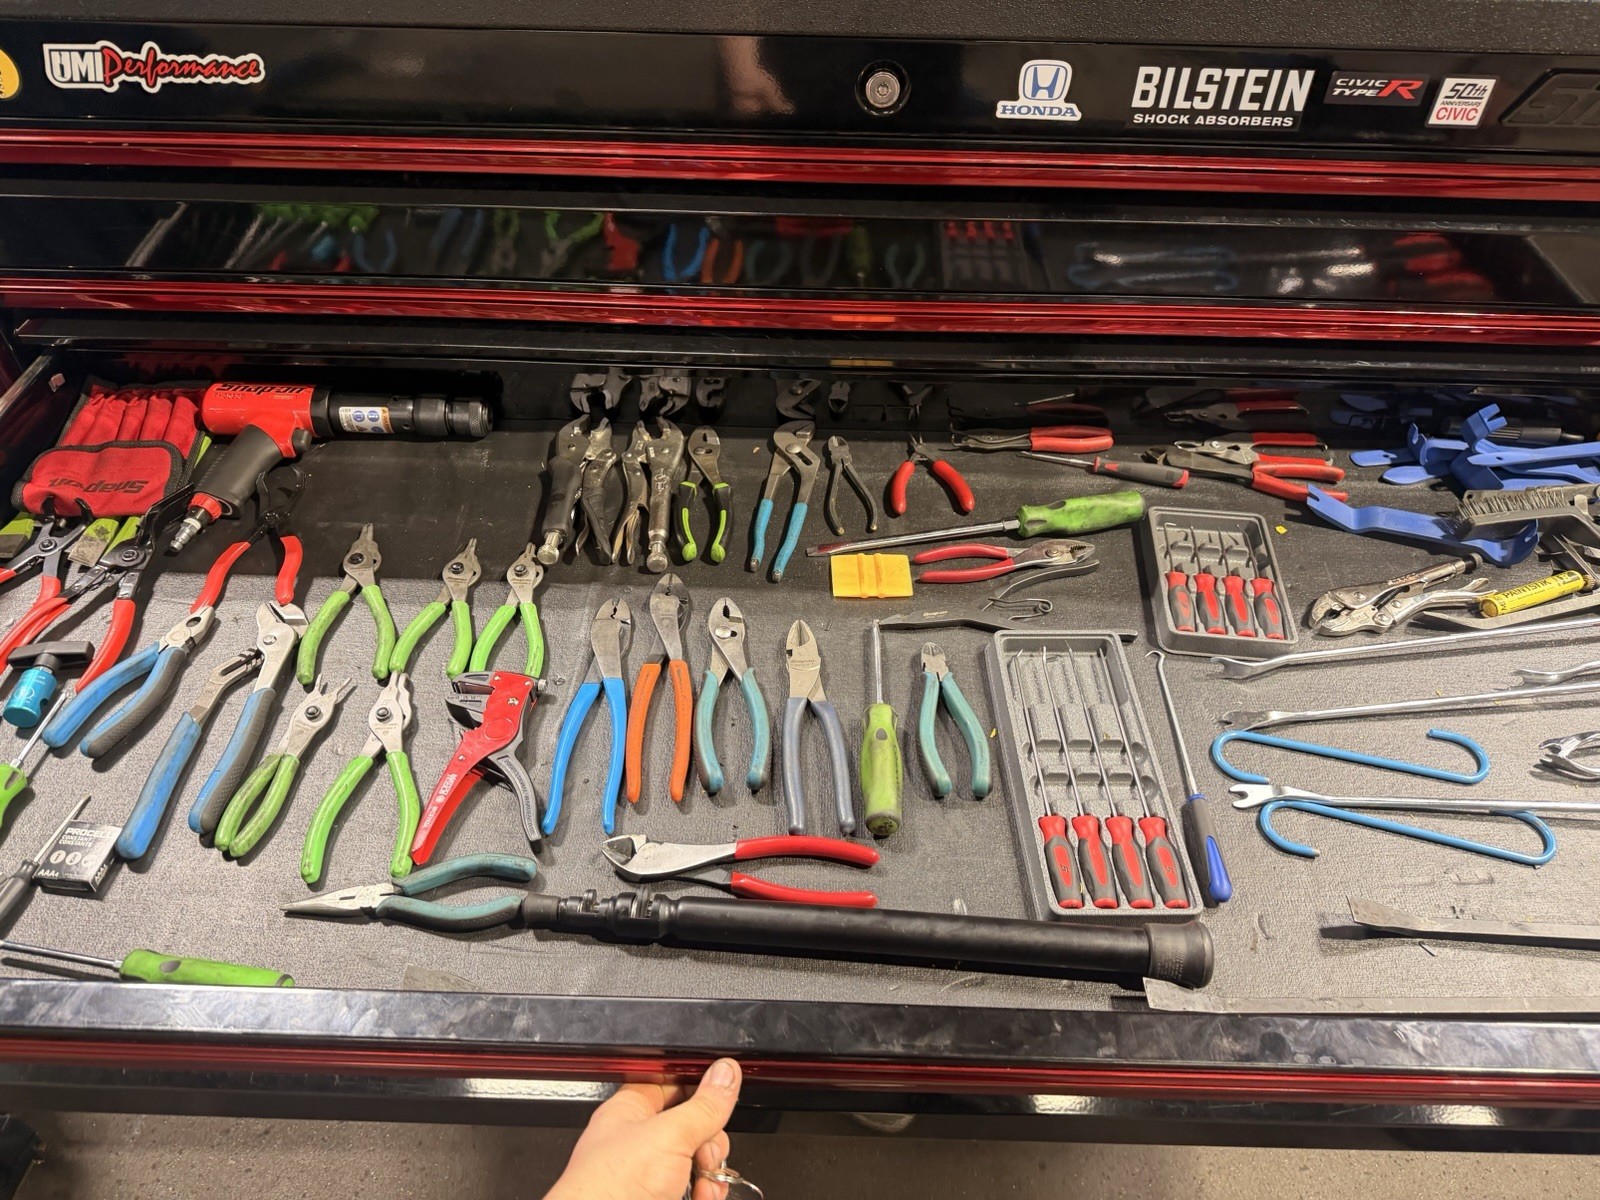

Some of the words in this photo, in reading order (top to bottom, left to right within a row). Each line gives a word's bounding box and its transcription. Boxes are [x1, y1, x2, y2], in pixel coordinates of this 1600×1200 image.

[51, 51, 102, 82] UMI
[101, 47, 260, 87] Performance
[1131, 66, 1315, 112] BILSTEIN
[1332, 87, 1381, 97] TYPE
[1376, 79, 1424, 100] R
[1335, 78, 1389, 87] CIVIC
[1443, 82, 1488, 100] 50th
[1000, 104, 1077, 118] HONDA
[1439, 100, 1483, 108] ANNIVERSARY
[1133, 113, 1190, 125] SHOCK
[1194, 114, 1294, 127] ABSORBERS
[1435, 106, 1479, 122] CIVIC
